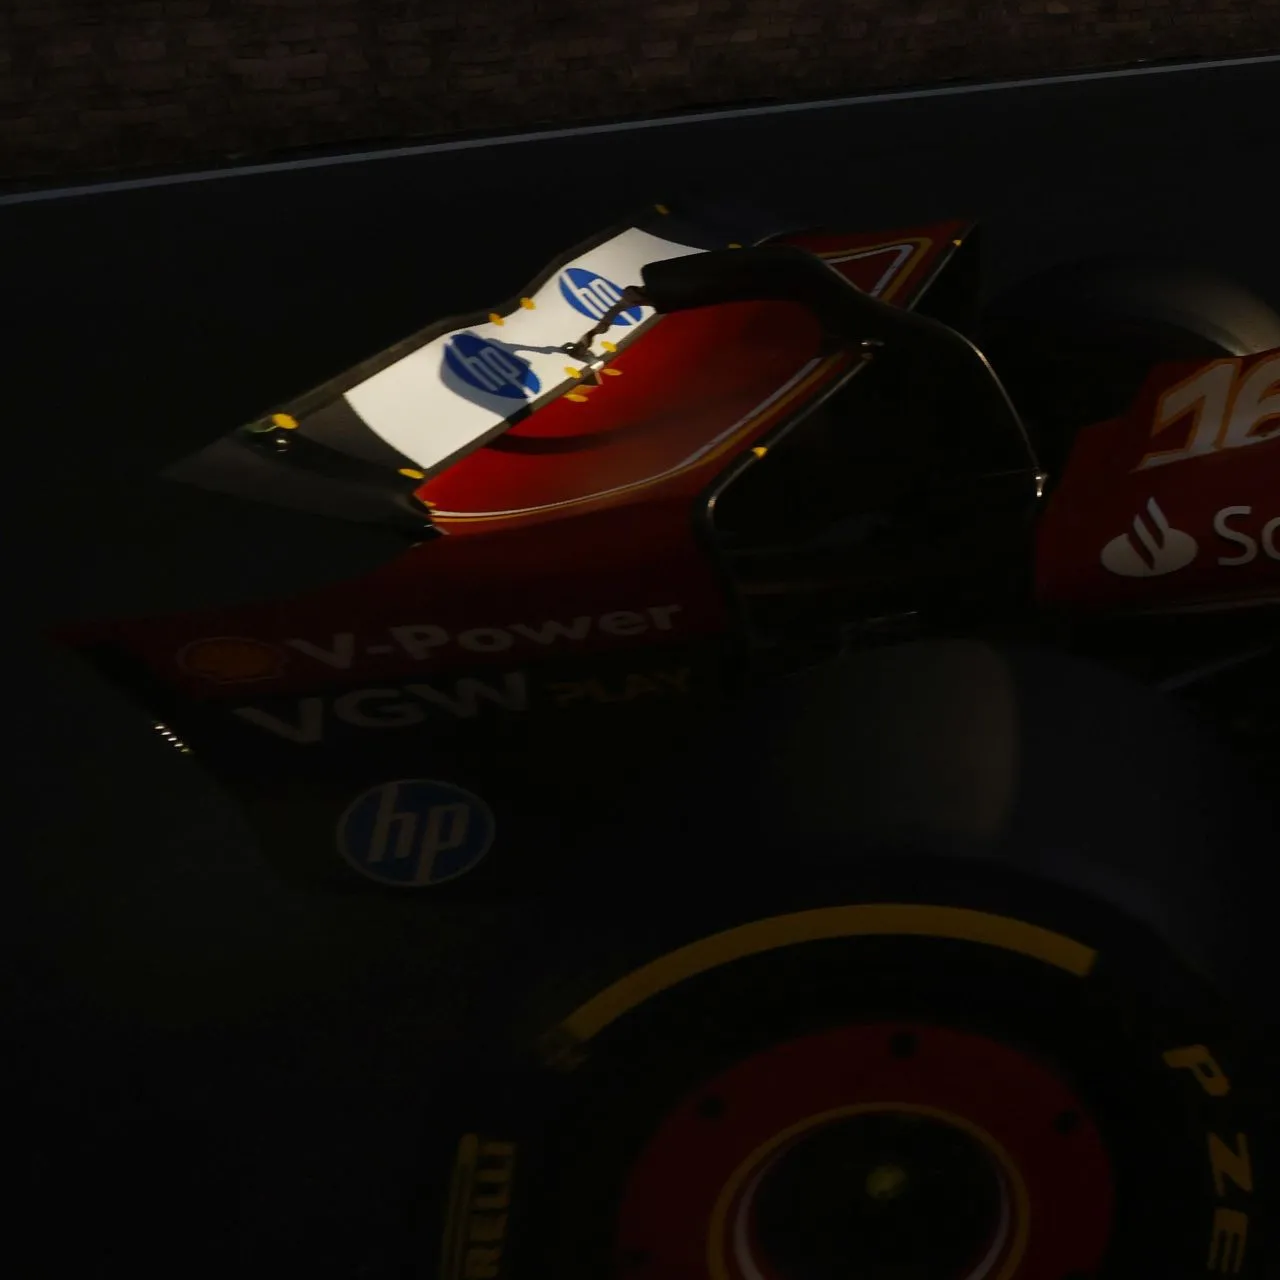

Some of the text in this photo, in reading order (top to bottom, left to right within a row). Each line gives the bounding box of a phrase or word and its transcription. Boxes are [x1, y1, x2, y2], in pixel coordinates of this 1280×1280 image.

[447, 337, 537, 399] hp
[284, 603, 685, 671] V-Power
[231, 670, 530, 746] VGW
[367, 782, 472, 886] hp
[1160, 1042, 1233, 1099] P
